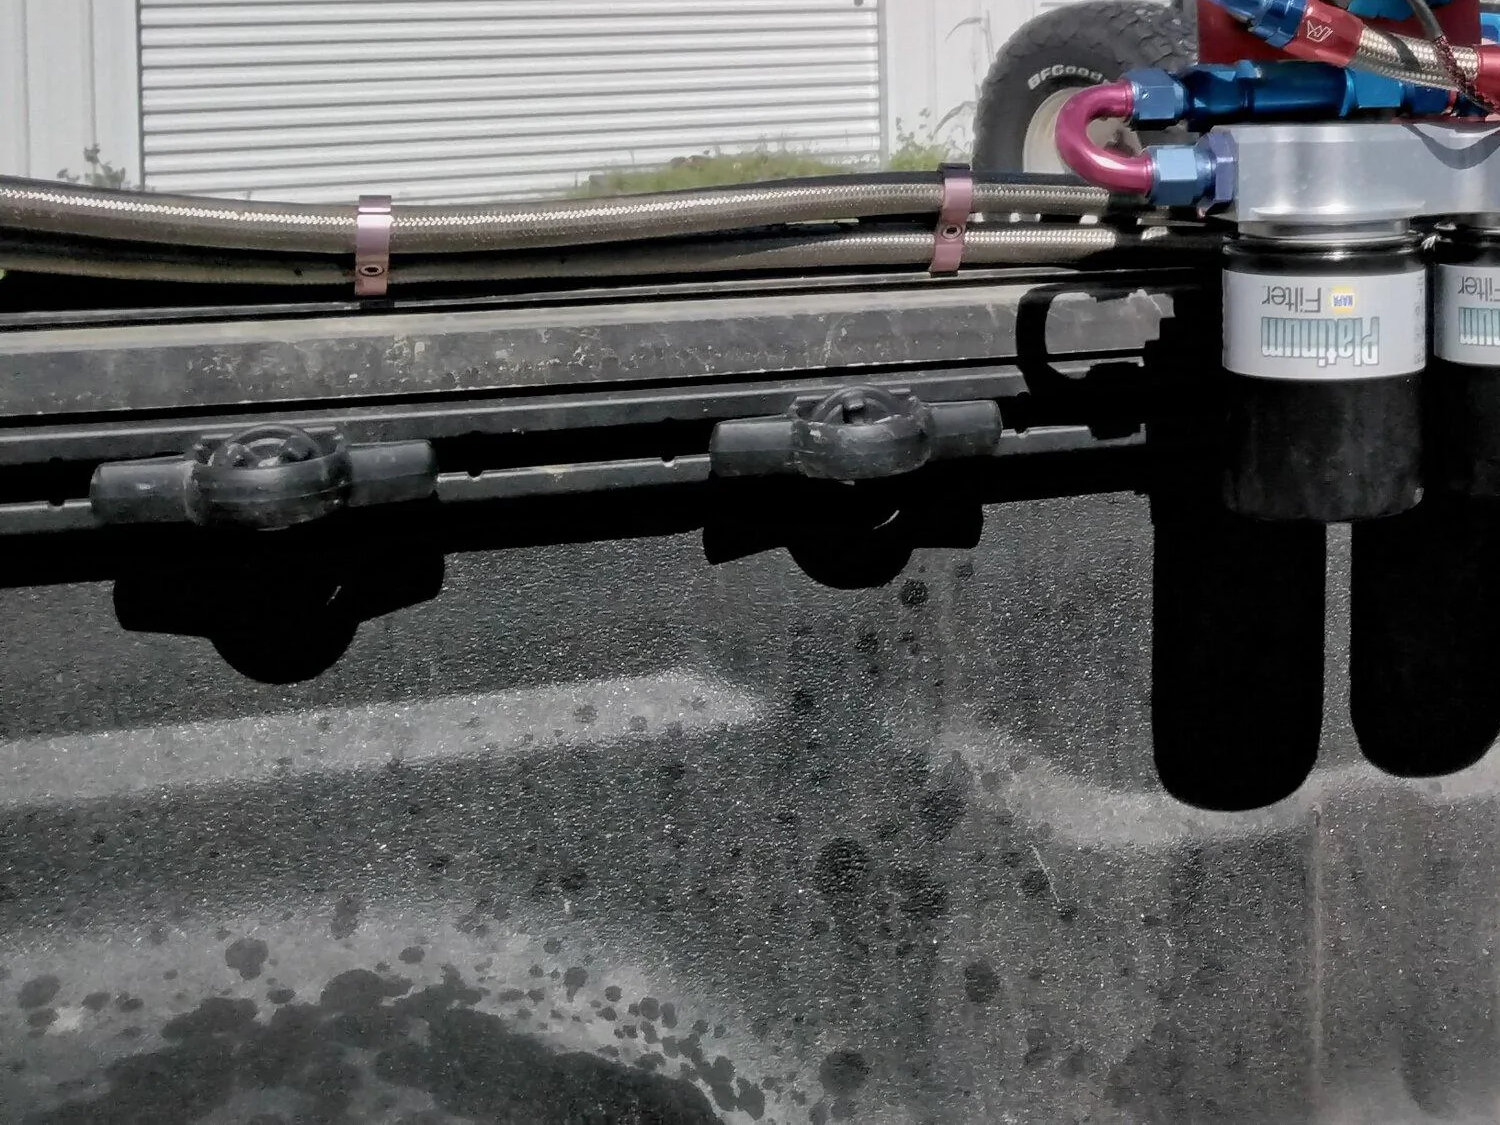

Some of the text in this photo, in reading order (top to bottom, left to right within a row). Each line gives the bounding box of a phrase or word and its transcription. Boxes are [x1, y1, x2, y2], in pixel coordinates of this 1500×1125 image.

[1261, 285, 1353, 313] NAPA Filter
[1260, 316, 1380, 368] Platinum
